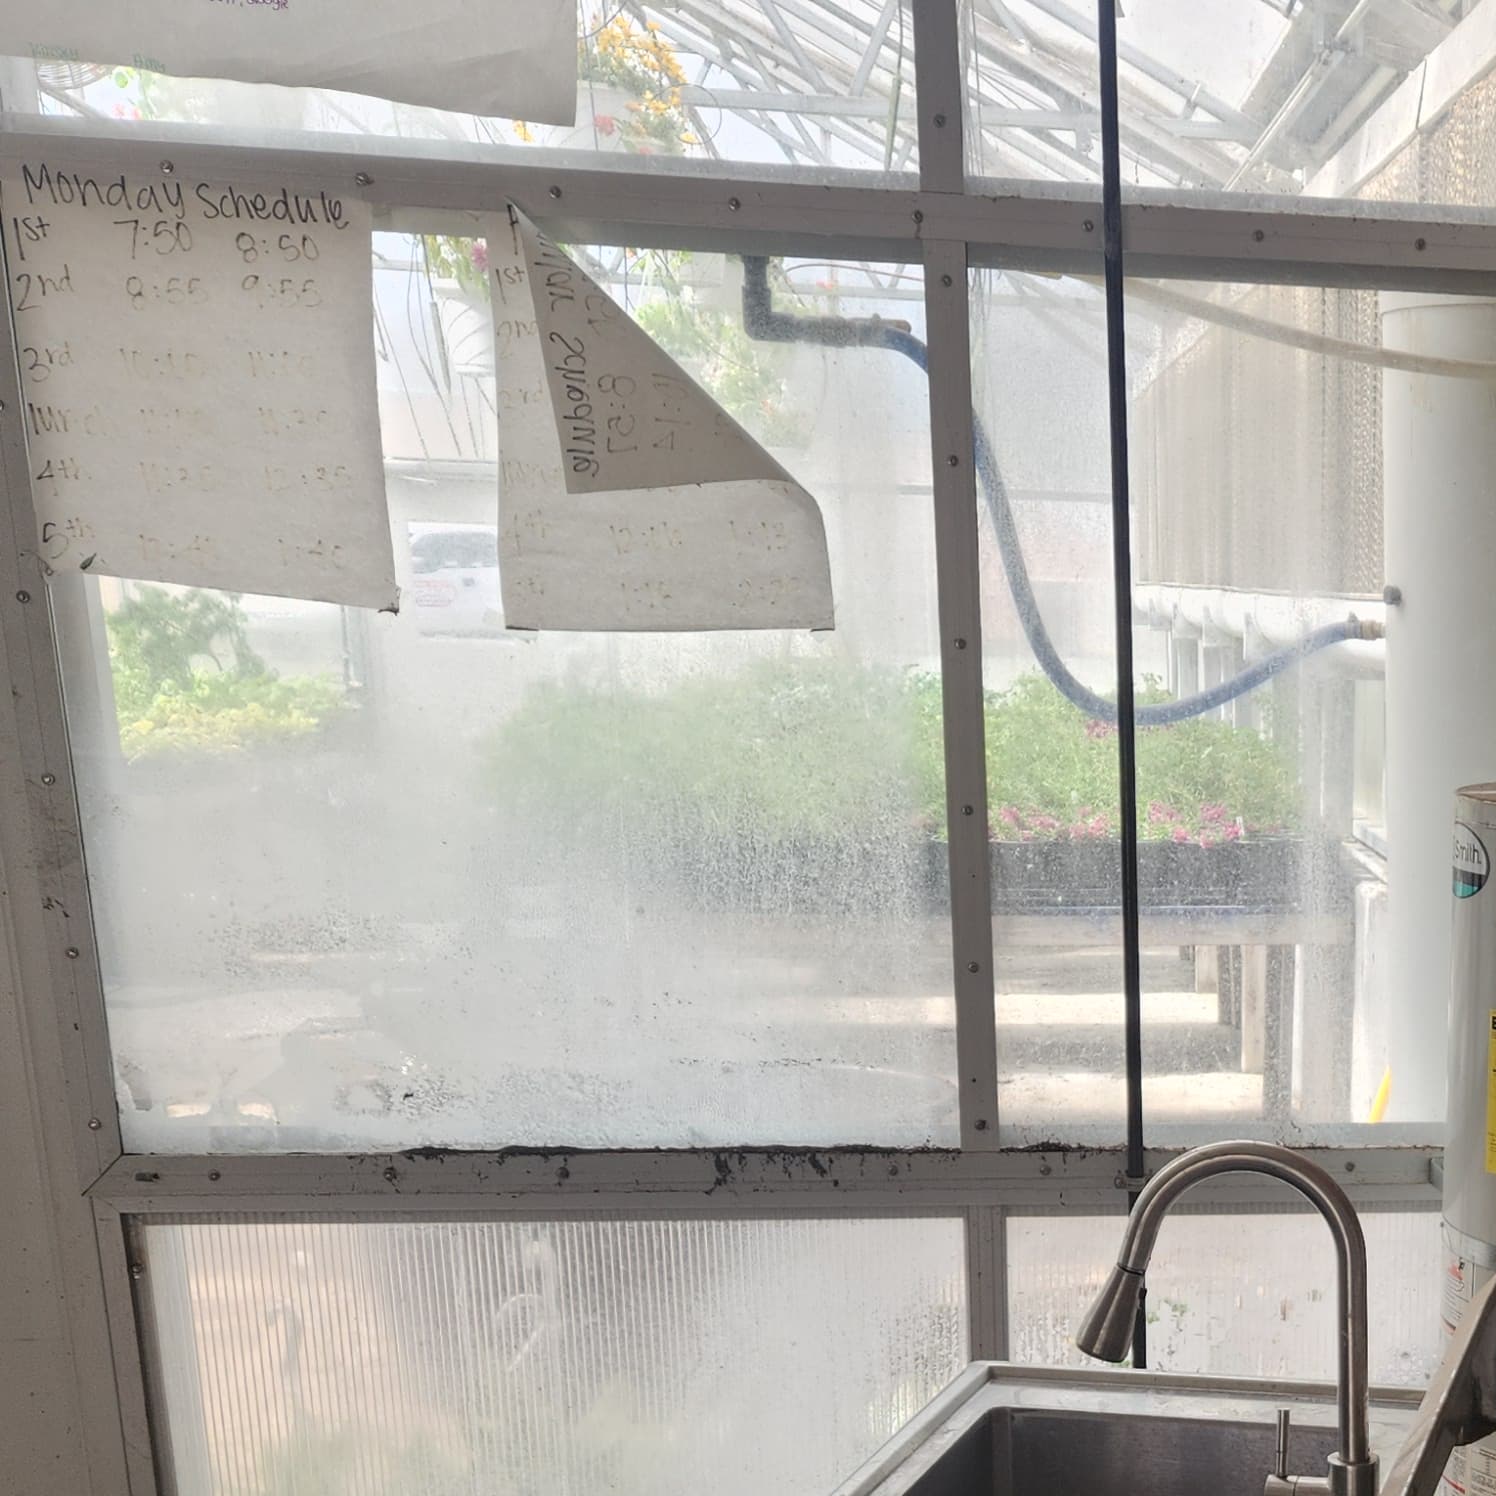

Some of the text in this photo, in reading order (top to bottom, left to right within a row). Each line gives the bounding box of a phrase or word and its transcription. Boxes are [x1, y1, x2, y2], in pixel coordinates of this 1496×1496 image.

[23, 163, 348, 230] Monday Schedule
[13, 215, 320, 264] 1st 7:50 8:50
[16, 264, 73, 312] 2nd
[126, 276, 207, 311] 8:55
[496, 266, 525, 303] 1st
[23, 341, 73, 383] 3rd
[43, 516, 94, 560] 5th
